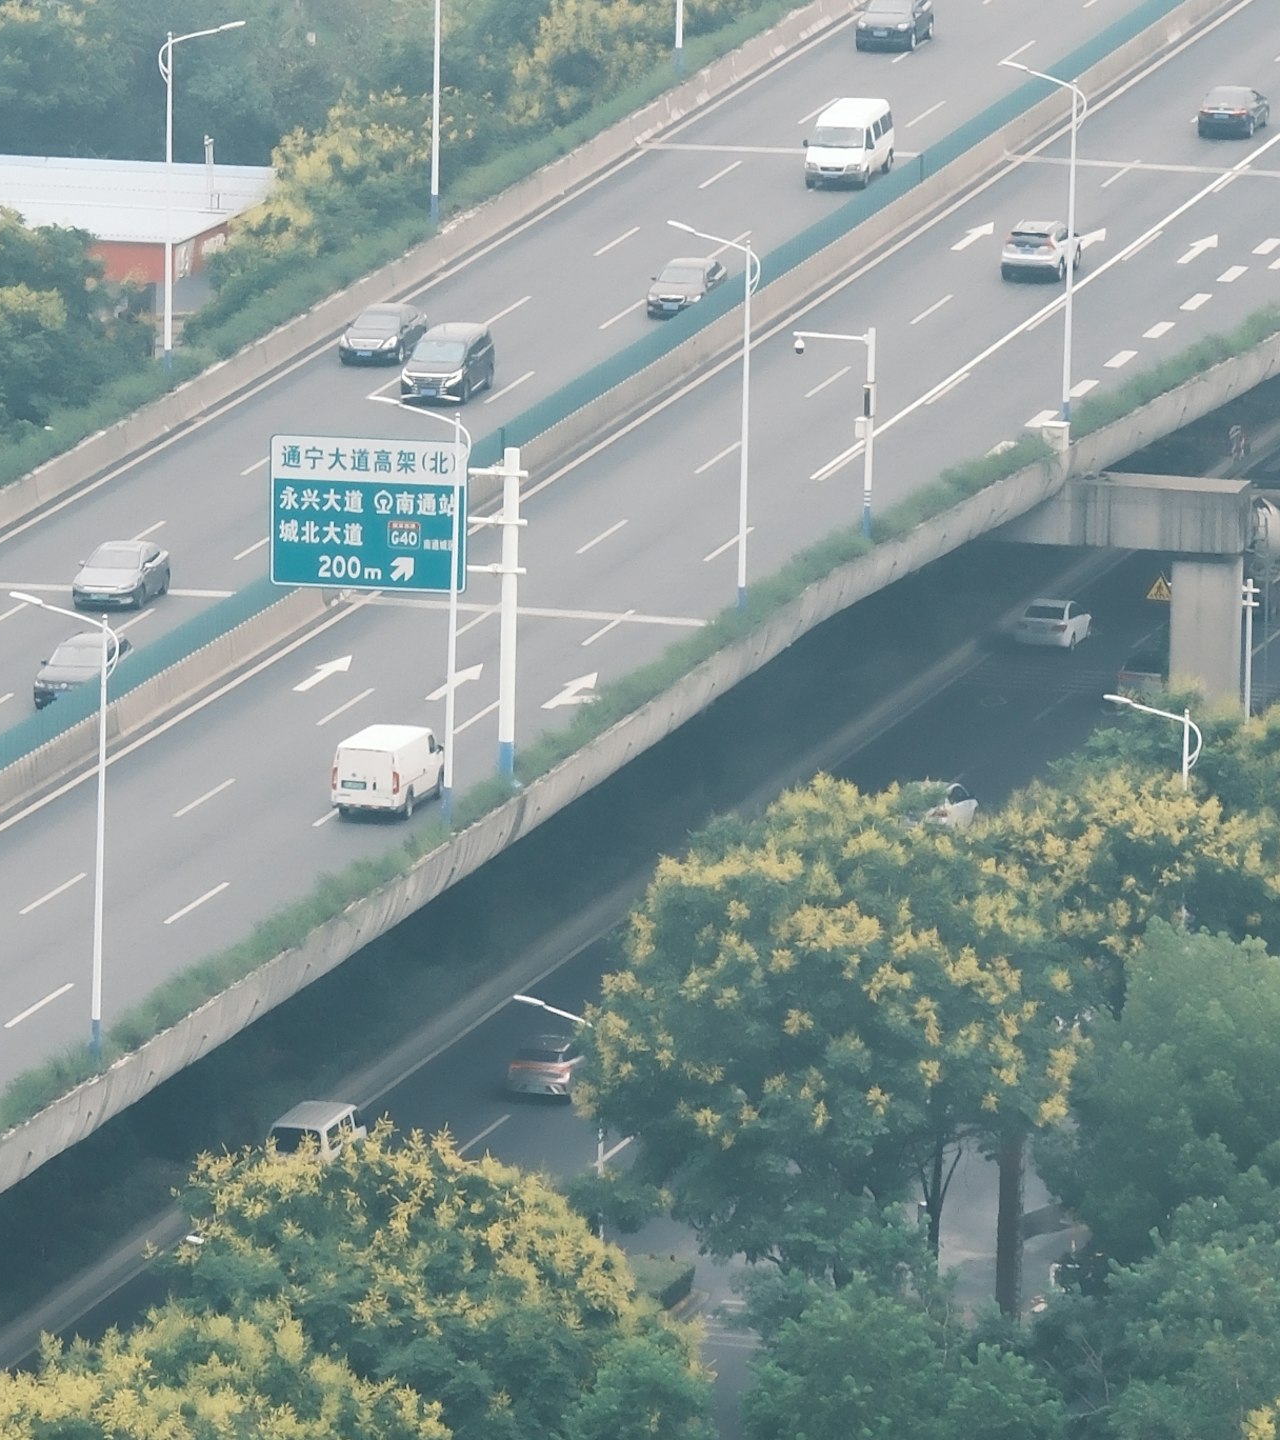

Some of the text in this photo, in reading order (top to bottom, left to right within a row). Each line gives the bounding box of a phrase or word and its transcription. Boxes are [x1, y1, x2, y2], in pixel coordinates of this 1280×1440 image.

[281, 445, 456, 473] 通宁大道高架(北)
[279, 486, 455, 517] 永兴大道 南通站
[279, 519, 363, 546] 城北大道
[390, 531, 418, 546] G40
